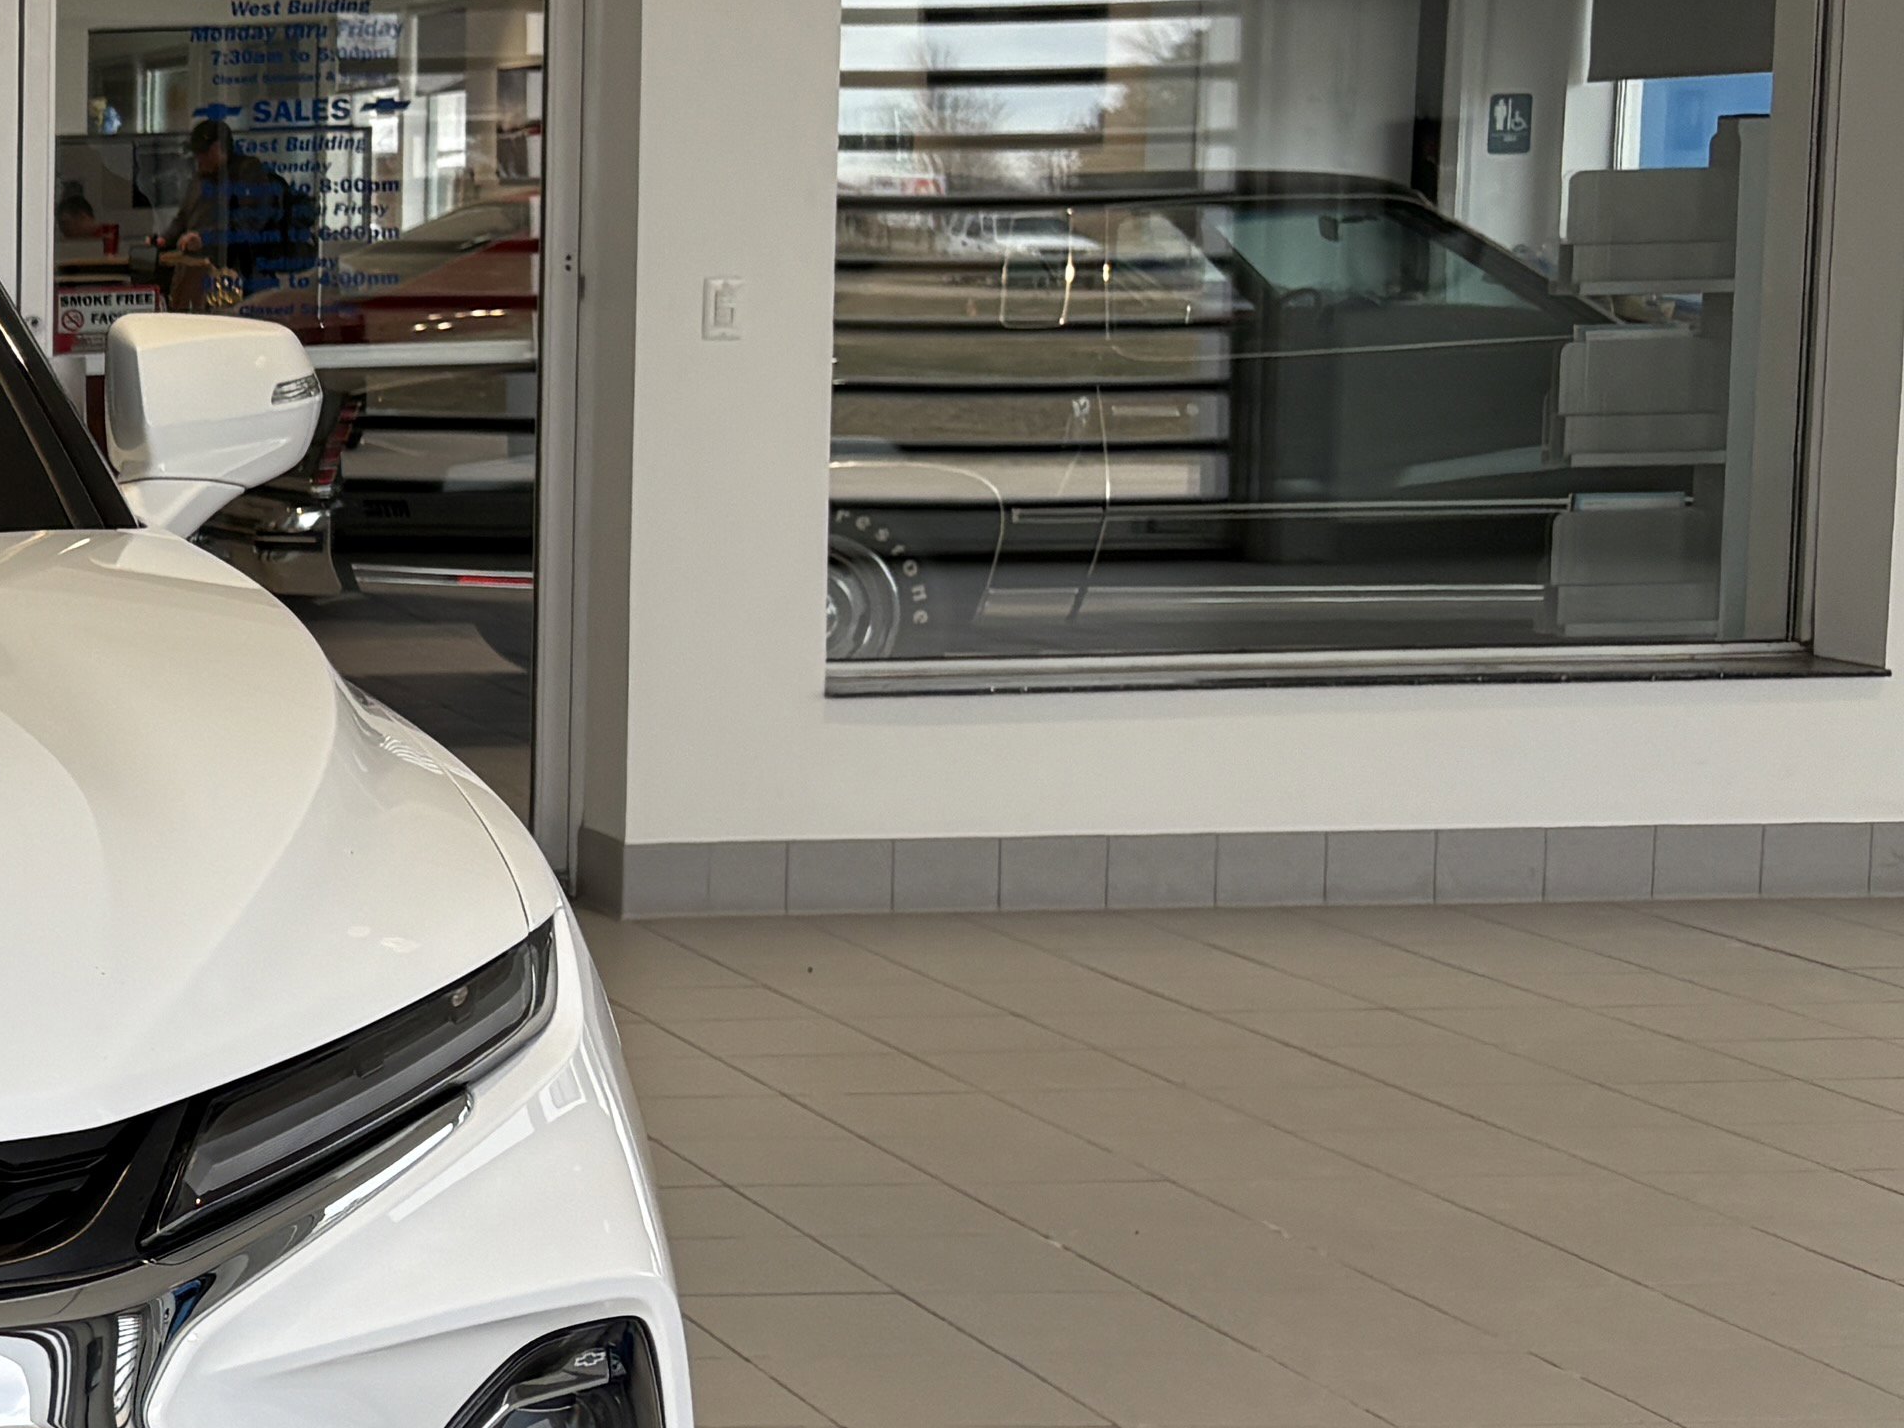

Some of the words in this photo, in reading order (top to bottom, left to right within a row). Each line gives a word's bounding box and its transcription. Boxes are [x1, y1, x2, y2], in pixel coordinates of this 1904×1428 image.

[231, 0, 280, 17] West
[190, 26, 276, 44] Monday
[338, 20, 403, 39] Friday
[291, 48, 311, 64] to
[253, 98, 352, 123] SALES
[233, 138, 279, 154] East
[286, 136, 367, 154] Building
[60, 294, 112, 308] SMOKE
[116, 293, 153, 306] FREE
